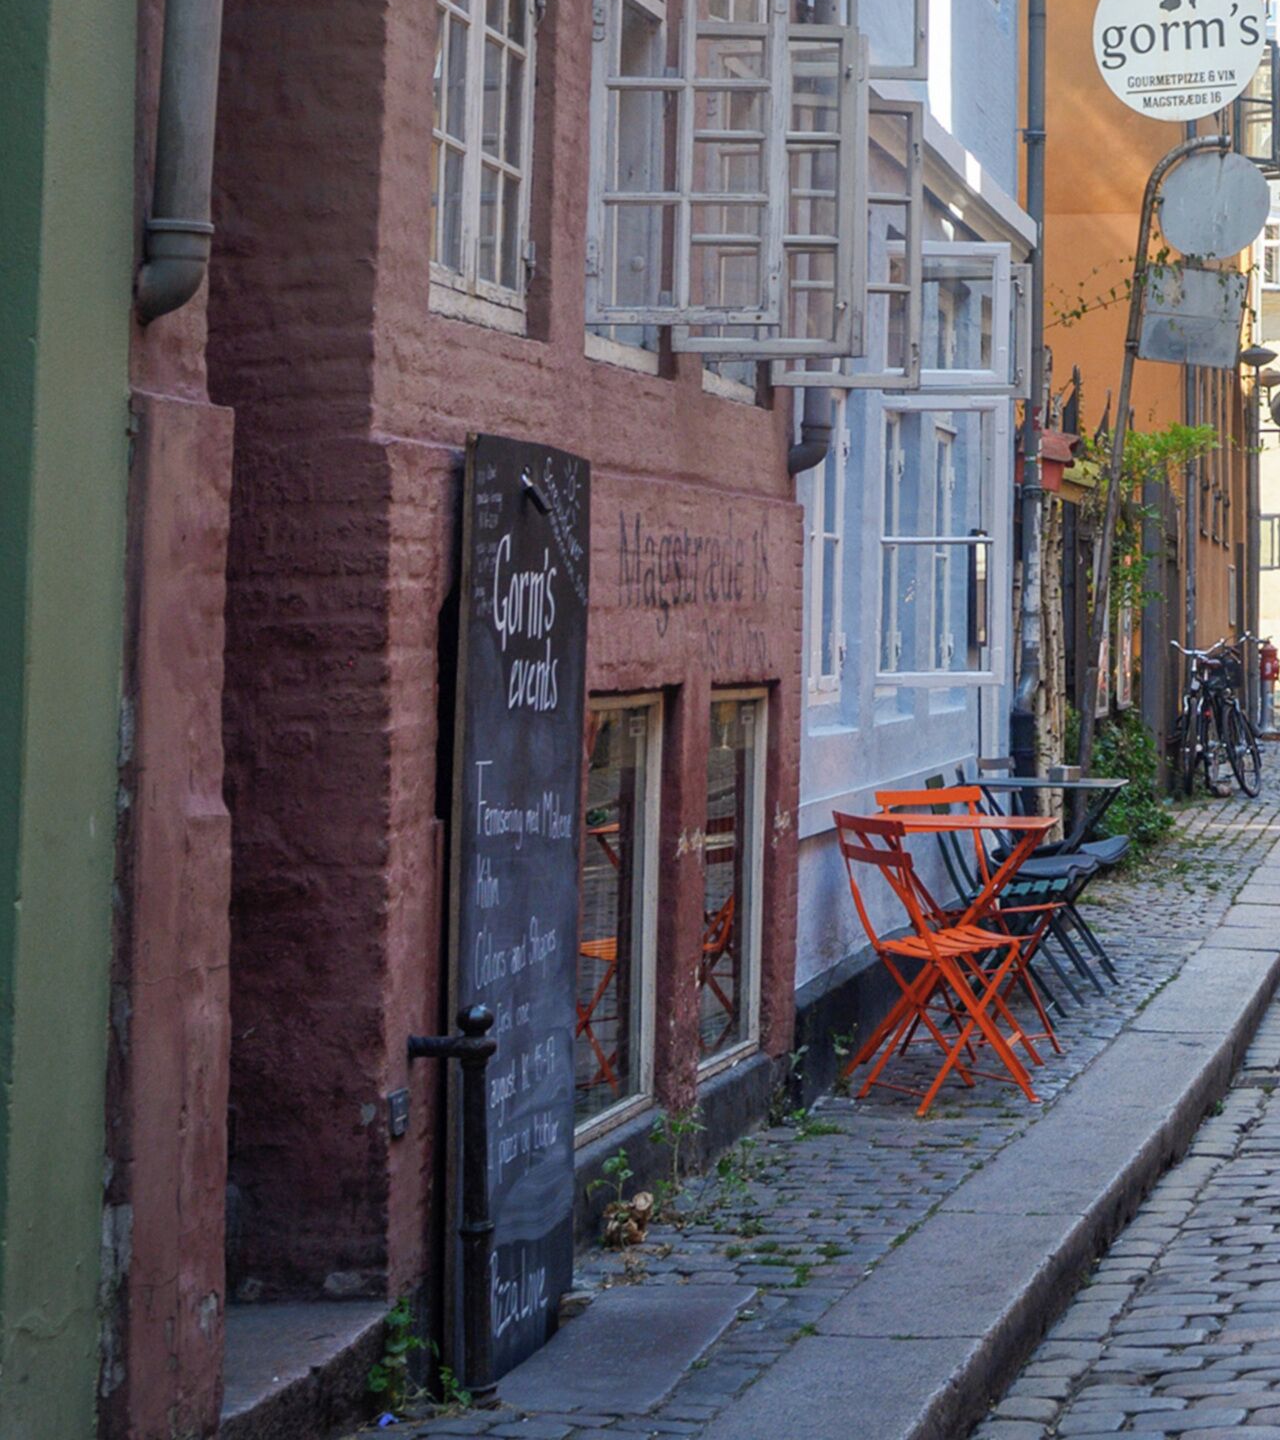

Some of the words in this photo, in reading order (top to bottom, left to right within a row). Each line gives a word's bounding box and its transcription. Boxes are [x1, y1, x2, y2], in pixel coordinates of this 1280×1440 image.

[1102, 2, 1260, 70] gorm's
[1127, 72, 1206, 89] GOURMETPIZZE
[1208, 70, 1216, 83] &
[1217, 69, 1236, 82] VIN
[1142, 93, 1208, 109] MAGSTRÆDE
[1210, 91, 1222, 105] 16
[494, 533, 557, 651] Gorm's
[508, 637, 559, 711] events
